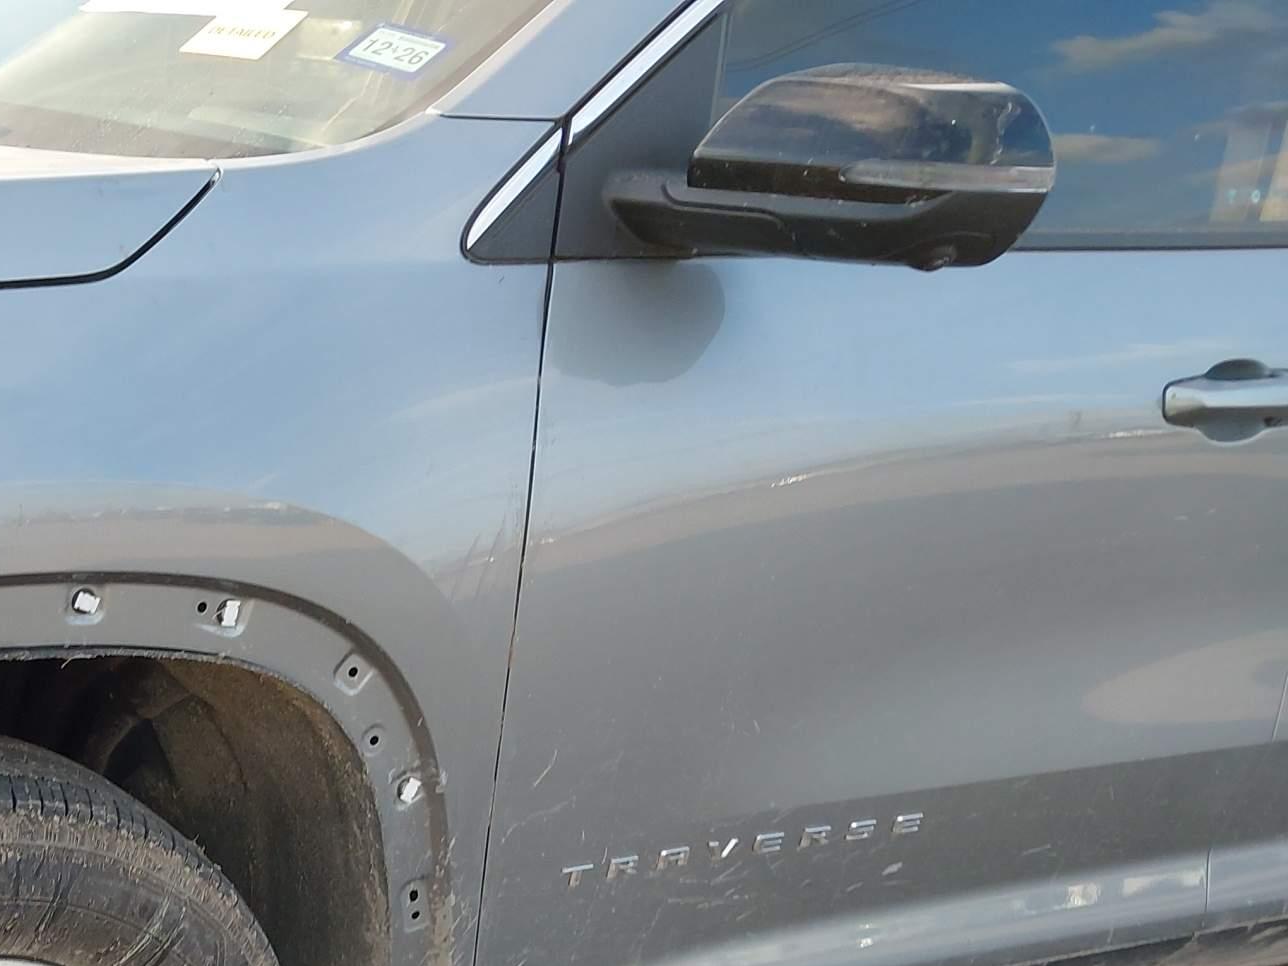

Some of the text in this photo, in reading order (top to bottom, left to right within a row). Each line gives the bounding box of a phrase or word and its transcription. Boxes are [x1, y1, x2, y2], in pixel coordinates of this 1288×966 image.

[362, 38, 393, 56] 12
[394, 47, 429, 65] 26
[560, 812, 924, 888] TRAVERSE
